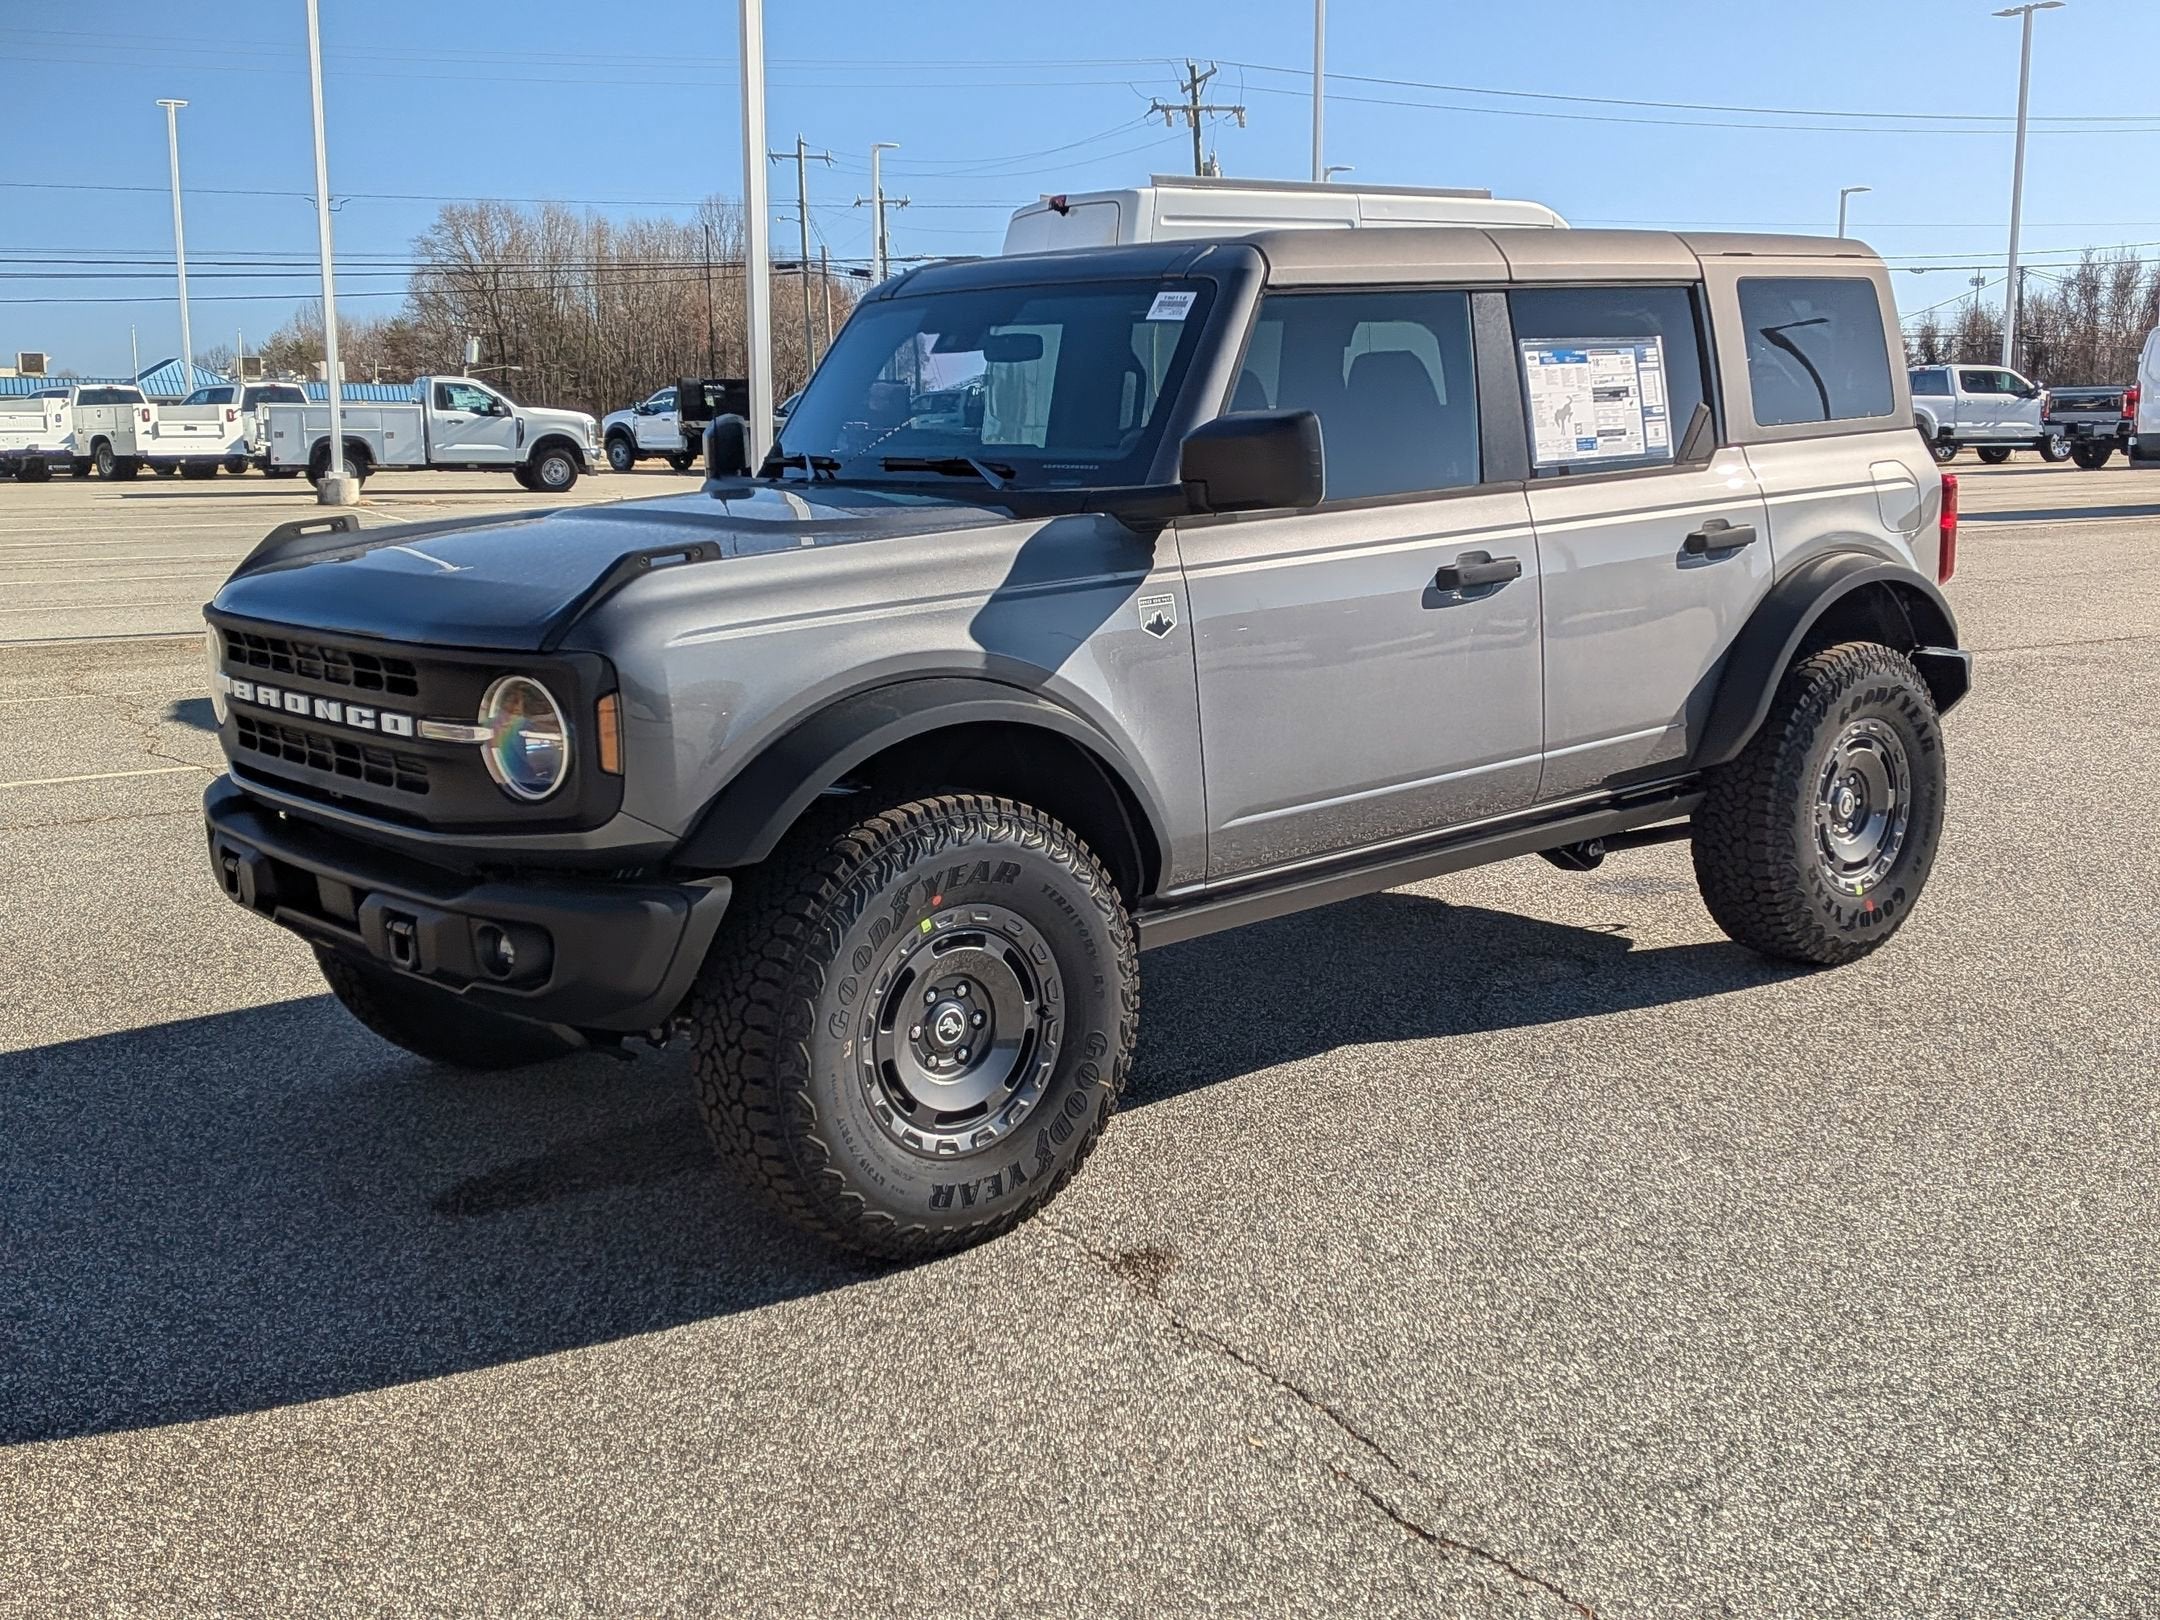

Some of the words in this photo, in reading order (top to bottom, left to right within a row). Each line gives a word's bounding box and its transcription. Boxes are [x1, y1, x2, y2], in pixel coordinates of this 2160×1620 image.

[231, 679, 413, 737] BRONCO
[829, 859, 1022, 1040] GOODYEAR
[927, 1031, 1108, 1212] GOODYEAR
